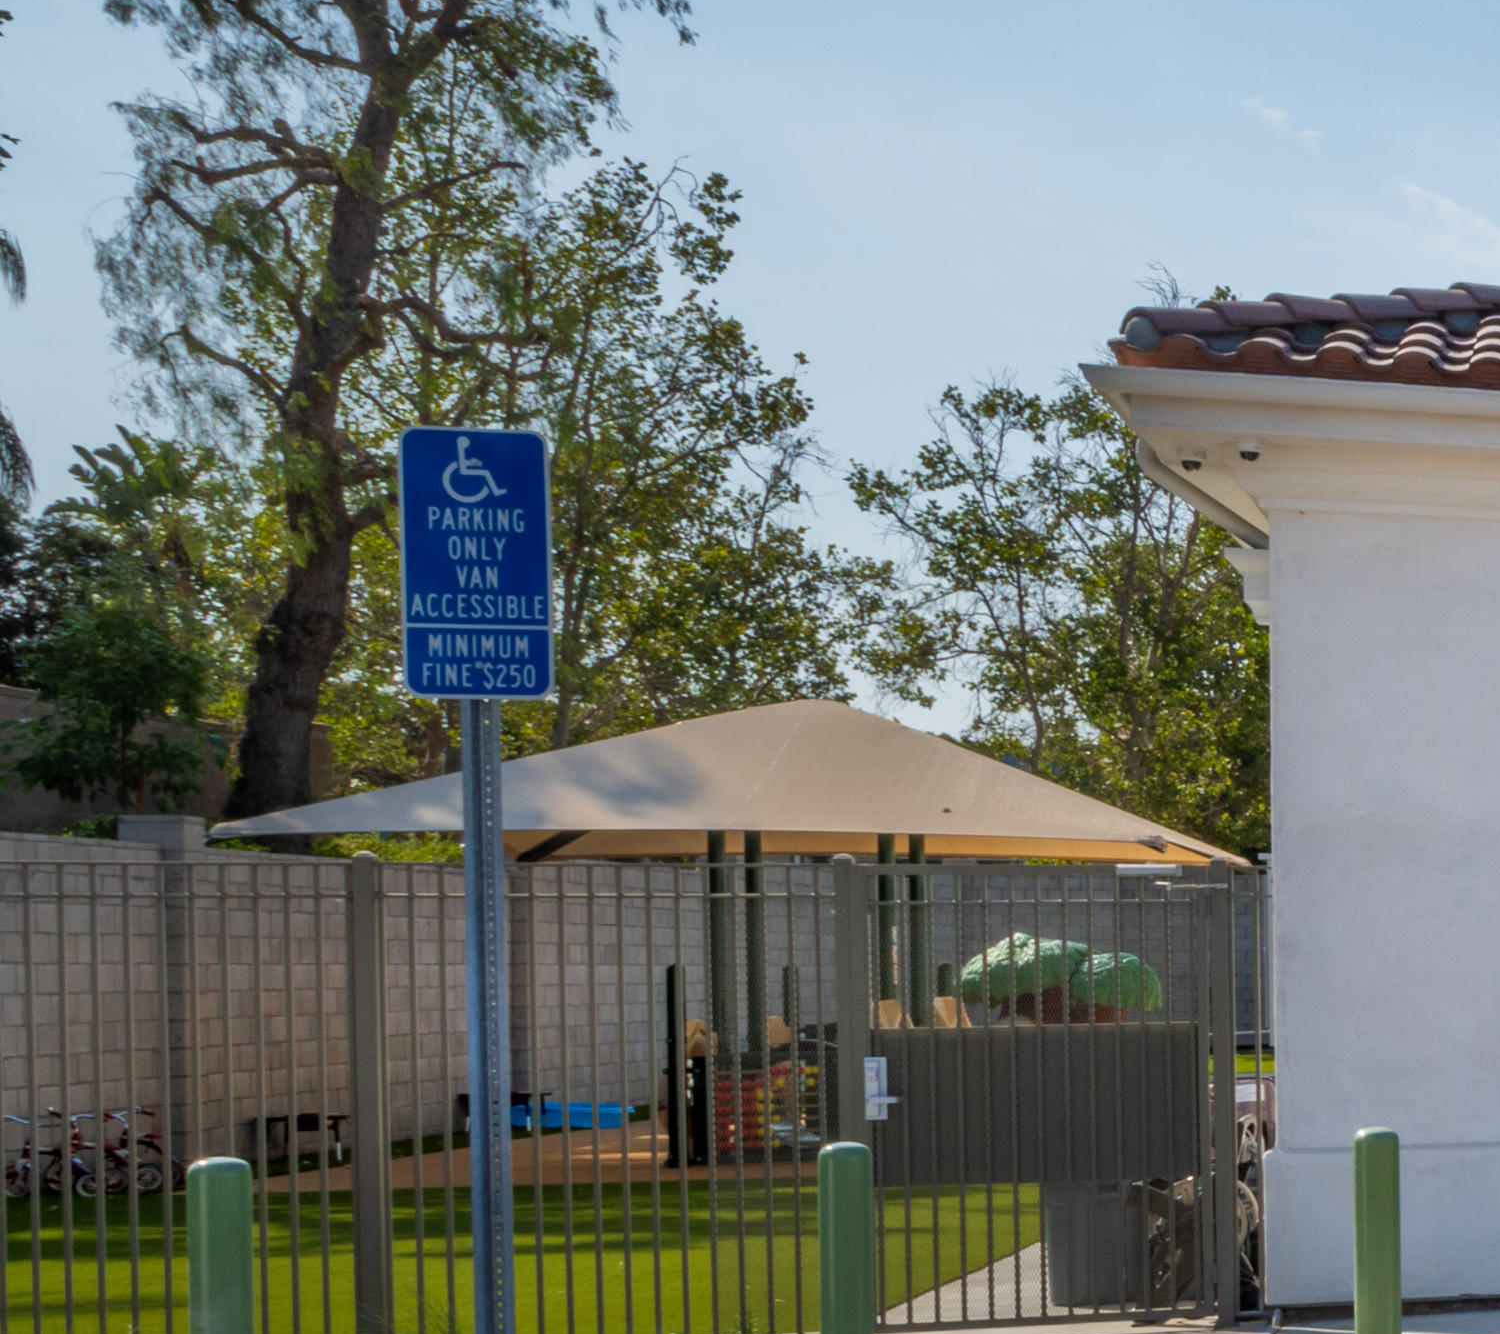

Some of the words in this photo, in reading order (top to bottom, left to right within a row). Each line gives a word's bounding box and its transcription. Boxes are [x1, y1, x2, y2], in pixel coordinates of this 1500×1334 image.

[428, 506, 525, 533] PARKING
[448, 536, 506, 561] ONLY
[456, 565, 499, 589] VAN
[411, 593, 545, 620] ACCESSIBLE
[428, 633, 530, 659] MINIMUM
[422, 662, 473, 687] FINE
[483, 663, 536, 689] $250
